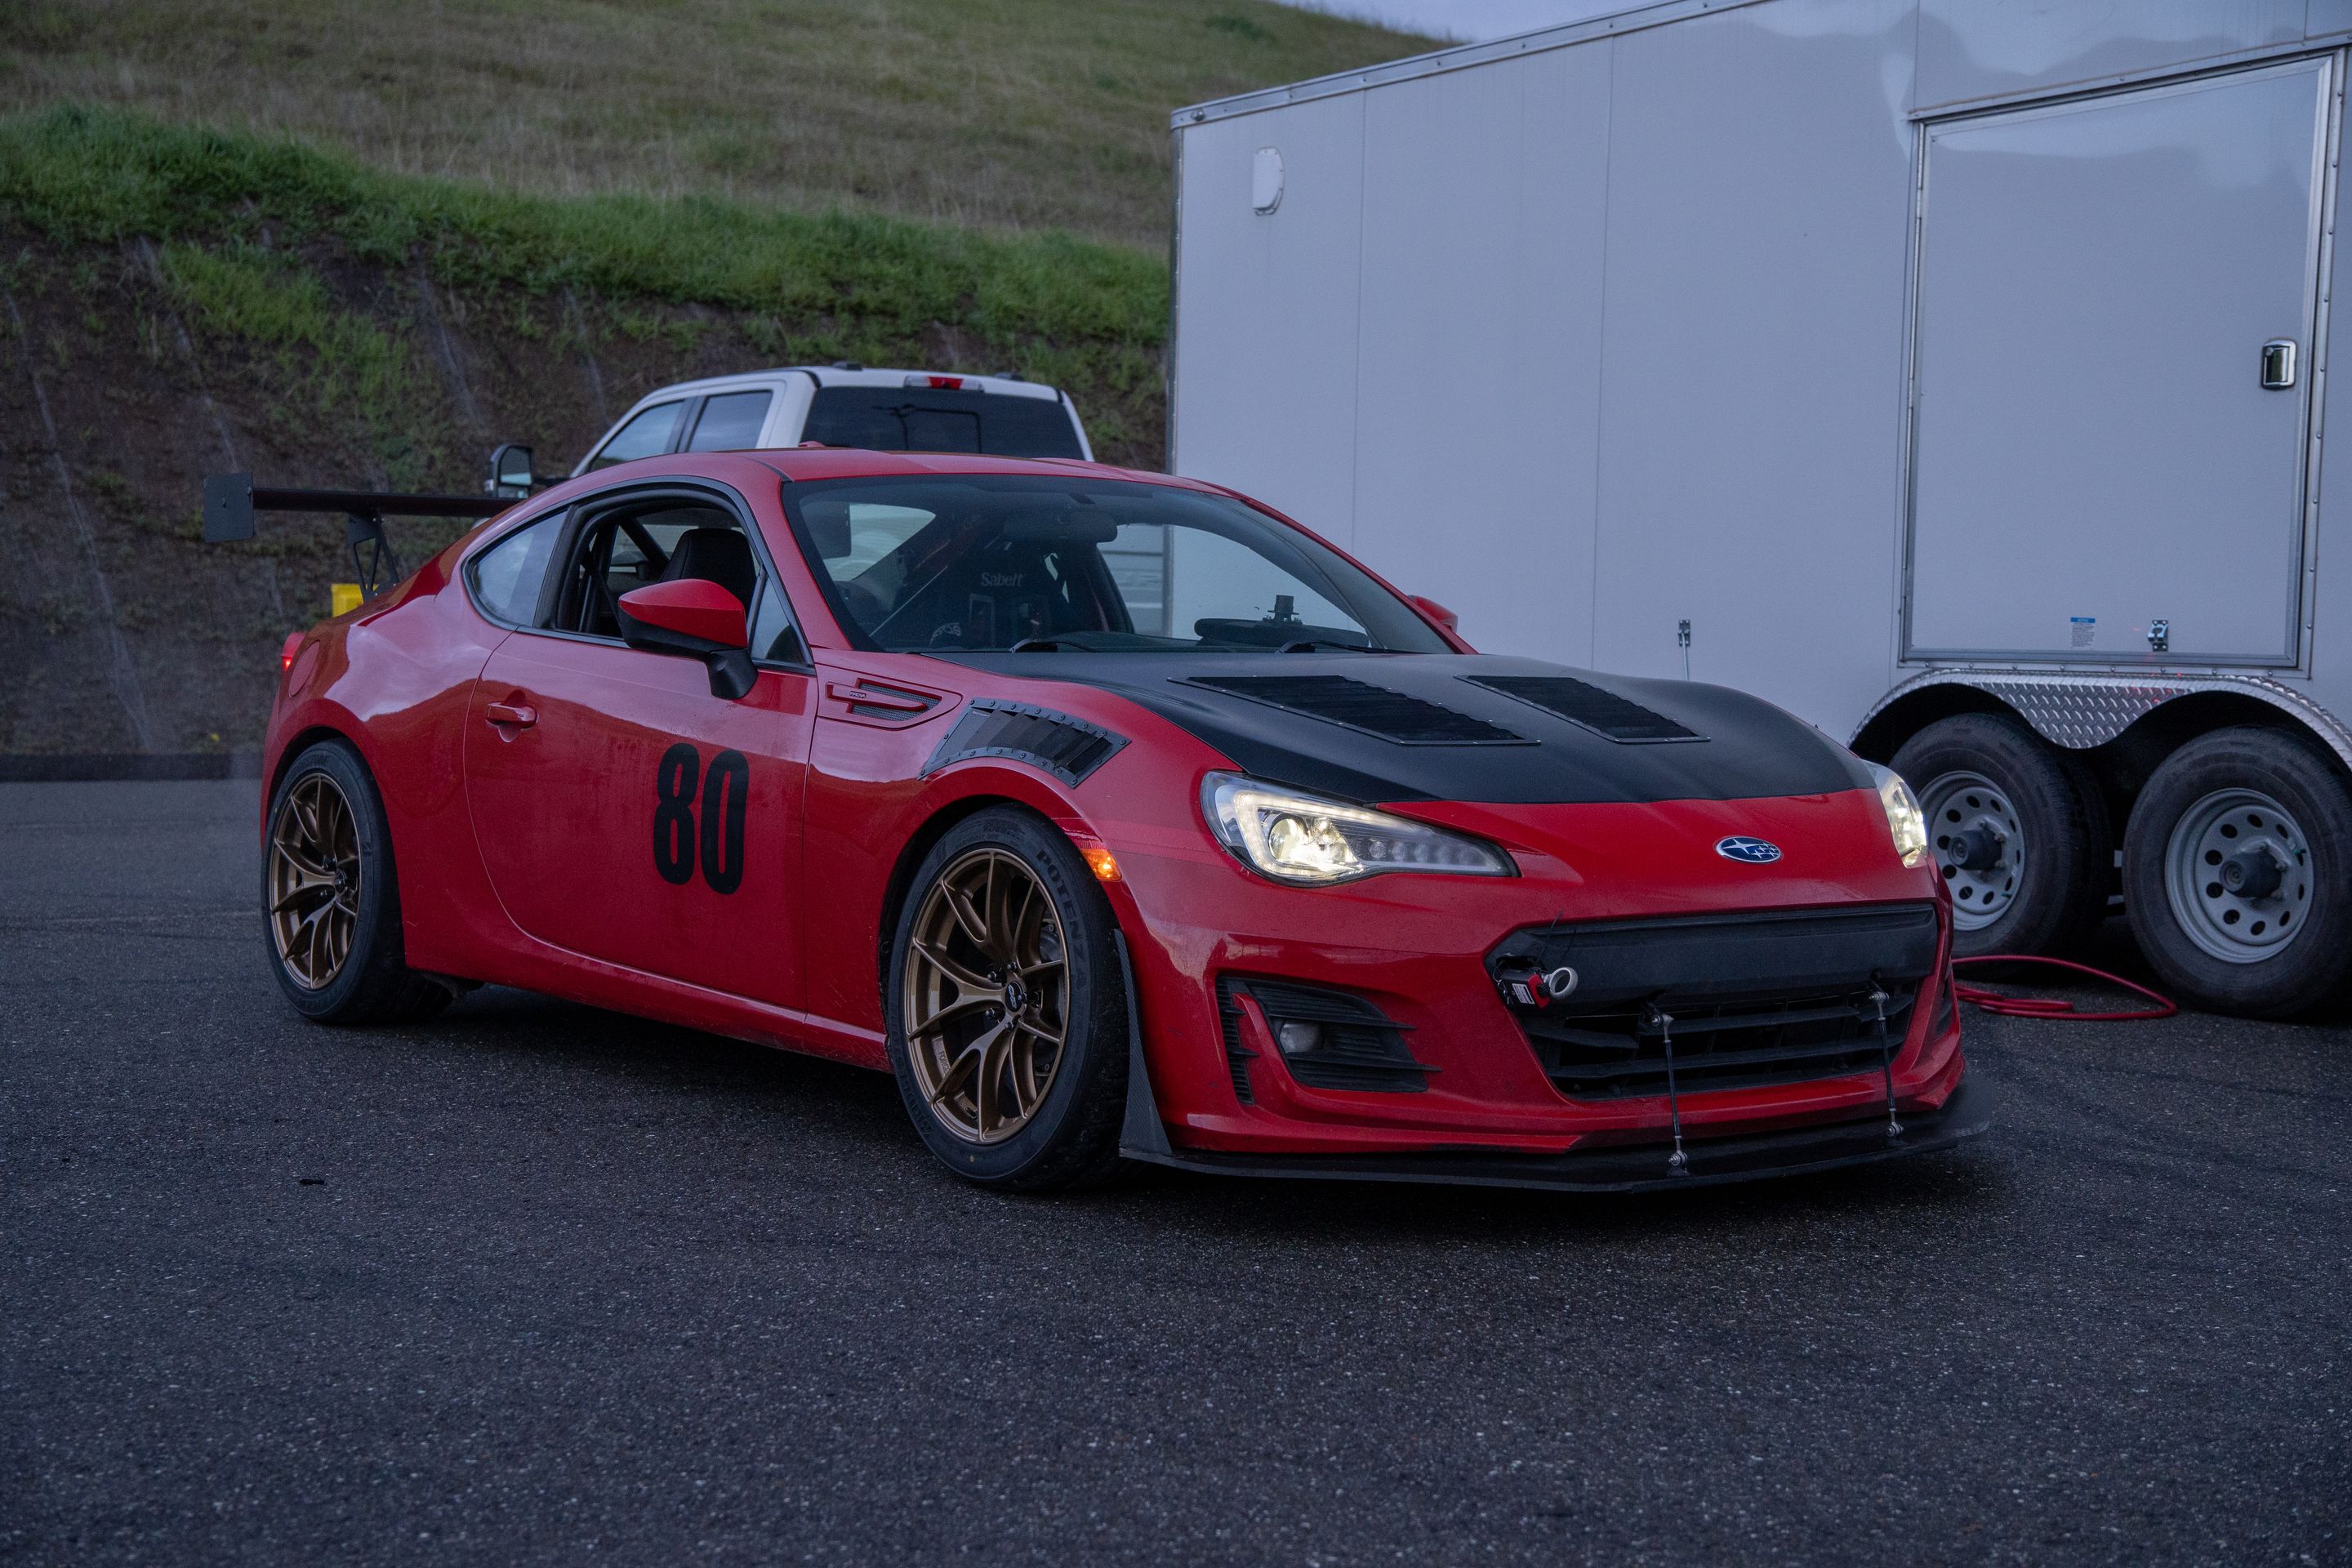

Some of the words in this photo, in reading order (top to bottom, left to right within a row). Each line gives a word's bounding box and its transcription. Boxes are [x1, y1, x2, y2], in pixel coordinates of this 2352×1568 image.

[980, 571, 1025, 587] Sabelt
[653, 742, 750, 895] 80
[1036, 849, 1087, 987] POTENZA
